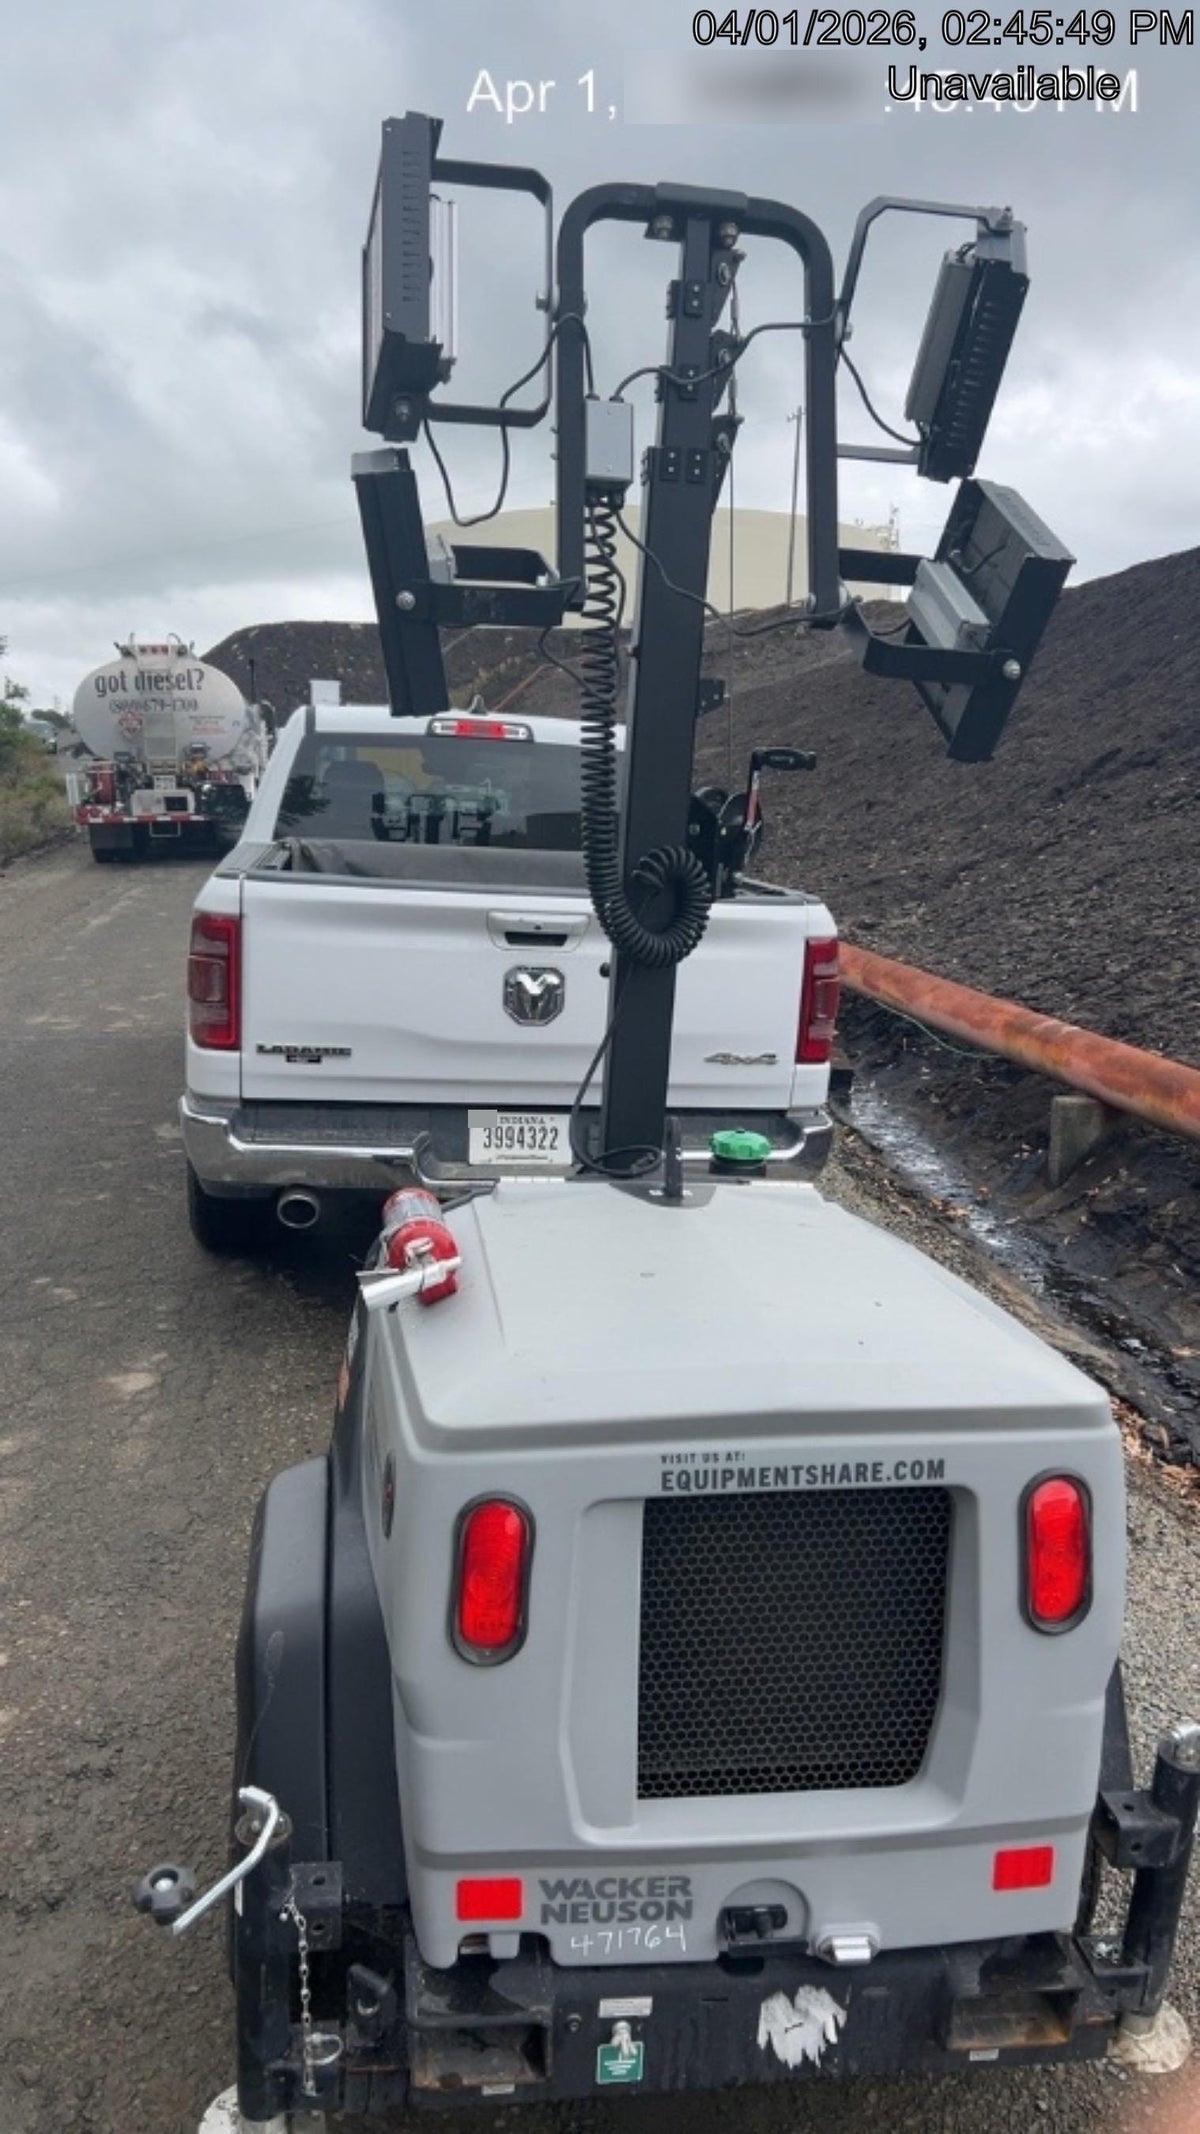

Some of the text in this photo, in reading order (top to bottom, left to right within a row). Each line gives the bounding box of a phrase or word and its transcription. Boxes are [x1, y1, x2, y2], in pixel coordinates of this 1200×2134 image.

[95, 668, 205, 698] got diesel?
[482, 1126, 559, 1151] 3994322
[661, 1453, 696, 1465] VISIT
[702, 1452, 720, 1464] US
[660, 1458, 946, 1492] EQUIPMENTSHARE.COM
[538, 1875, 694, 1900] WACKER
[540, 1899, 694, 1925] NEUSON
[570, 1923, 687, 1957] 471764
